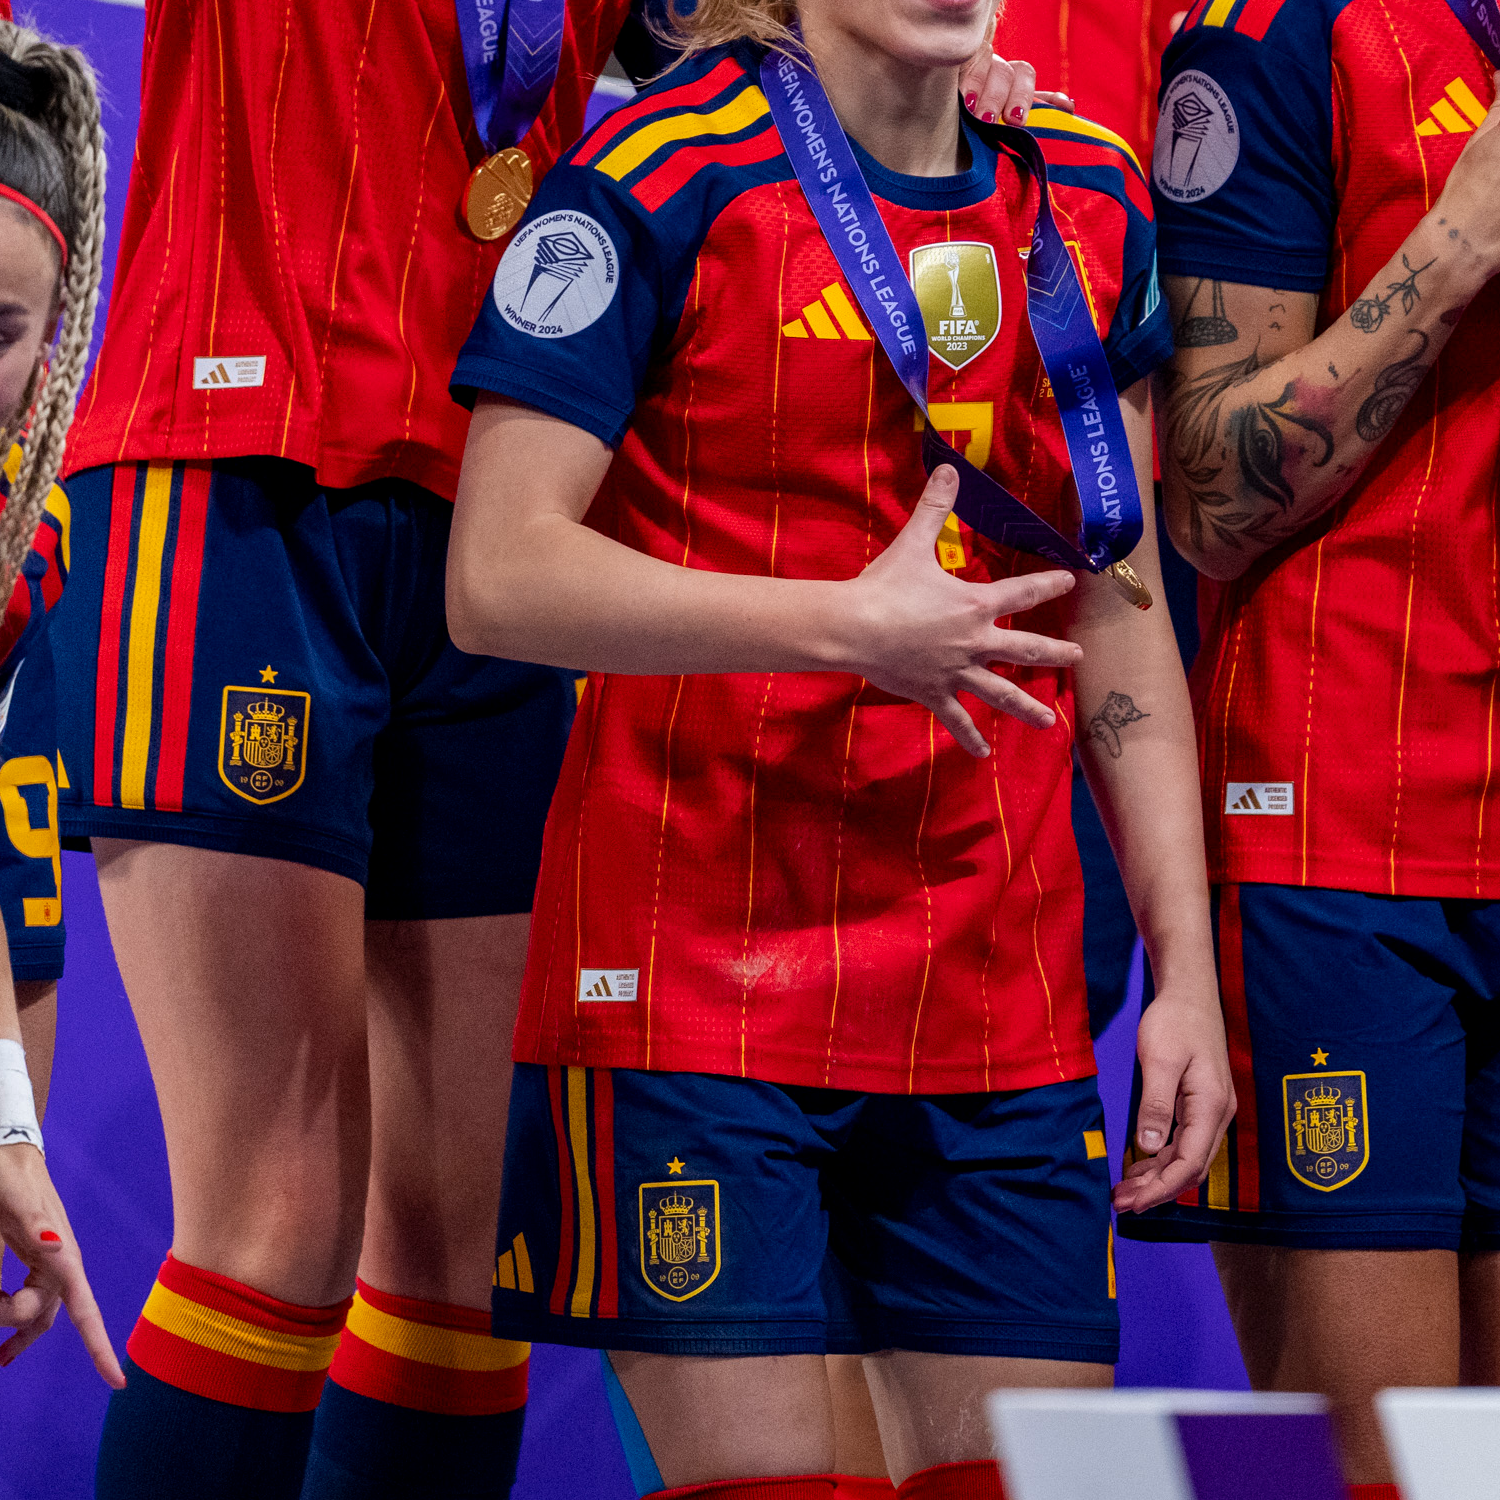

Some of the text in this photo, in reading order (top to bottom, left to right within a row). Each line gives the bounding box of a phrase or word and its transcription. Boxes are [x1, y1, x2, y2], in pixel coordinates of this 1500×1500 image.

[1193, 75, 1219, 99] NATIONS
[1217, 97, 1235, 134] LEAGUE
[777, 54, 916, 357] UEFA WOMEN'S NATIONS LEAGUE
[1185, 185, 1206, 199] 2024
[514, 213, 615, 284] UEFA WOMEN'S NATIONS LEAGUE
[504, 303, 564, 334] WINNER 2024
[939, 319, 978, 336] FIFA
[946, 341, 968, 351] 2023
[952, 334, 986, 342] CHAMPIONS
[1070, 364, 1105, 438] LEAGUE
